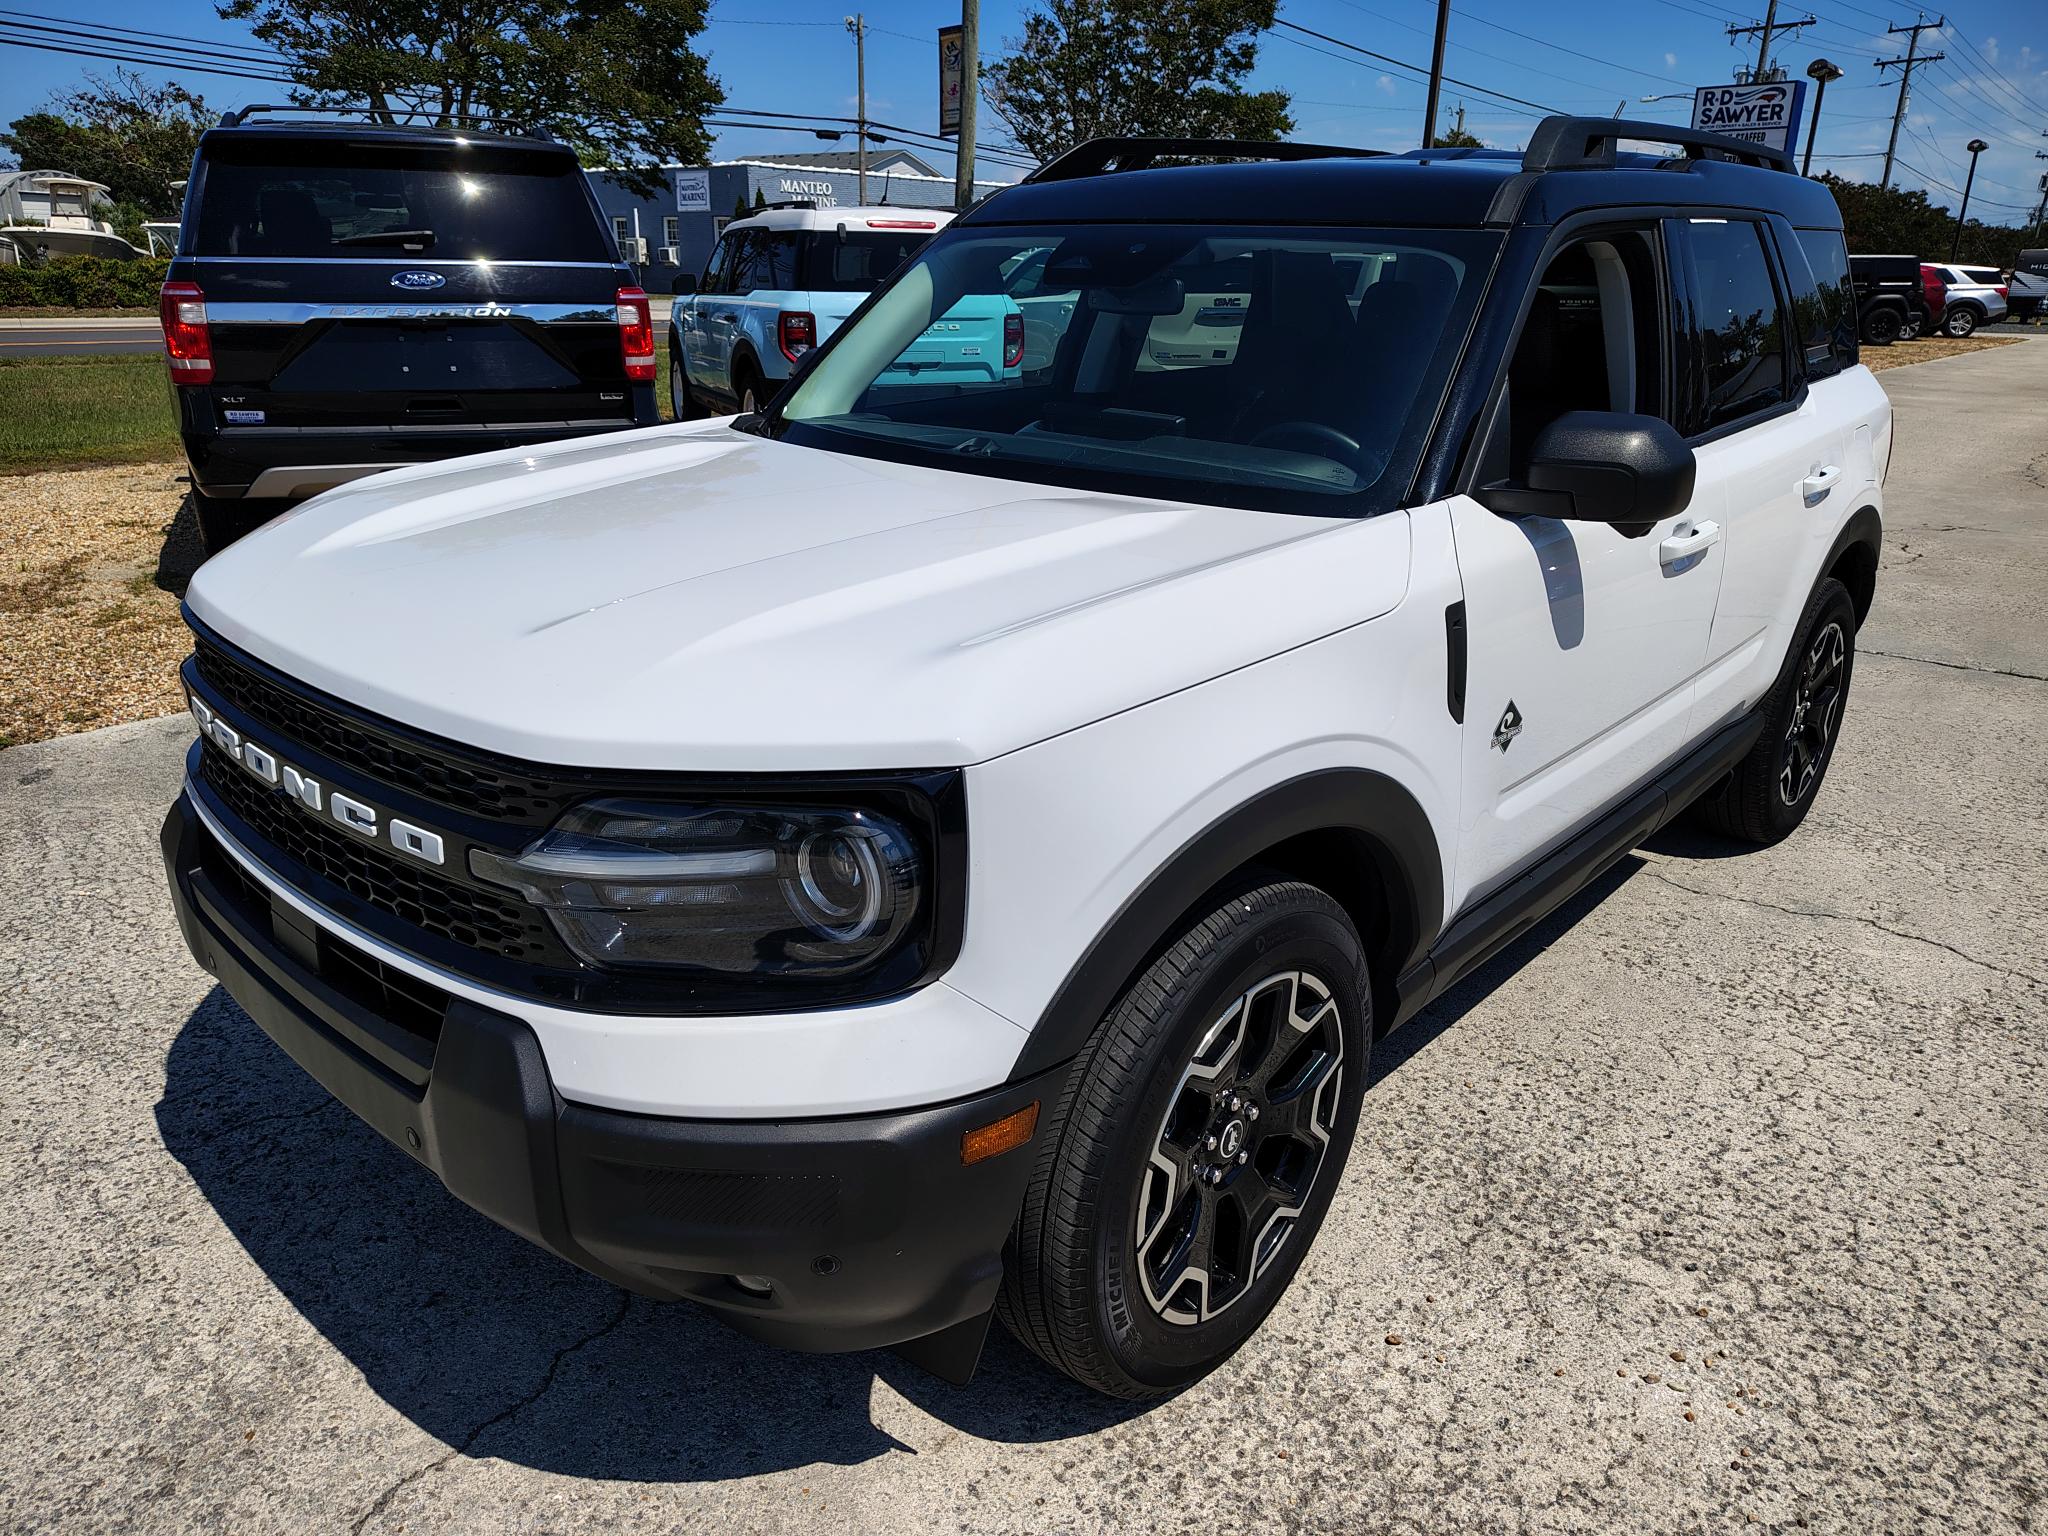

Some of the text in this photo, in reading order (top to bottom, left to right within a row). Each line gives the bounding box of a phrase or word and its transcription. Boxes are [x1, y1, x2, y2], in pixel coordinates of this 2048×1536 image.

[1700, 103, 1785, 125] SAWYER
[780, 178, 833, 195] MANTEO
[681, 192, 706, 201] MARINE
[404, 273, 433, 285] Ford
[1213, 297, 1242, 307] GMC
[328, 306, 512, 317] EXPEDITION
[191, 696, 445, 866] BRONCO
